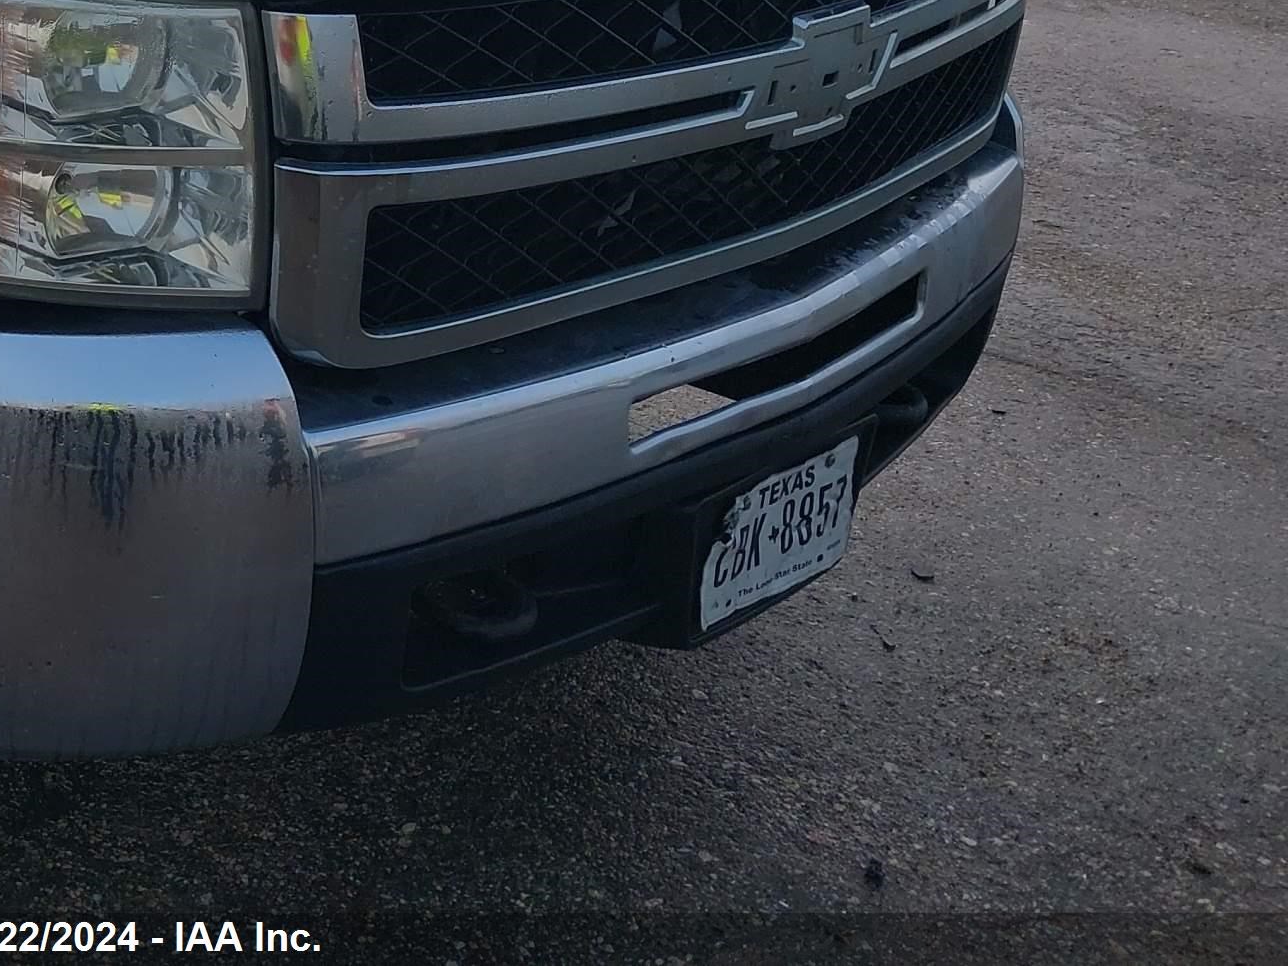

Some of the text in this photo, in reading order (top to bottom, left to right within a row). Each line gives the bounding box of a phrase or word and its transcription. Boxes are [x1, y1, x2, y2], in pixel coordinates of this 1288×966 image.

[759, 464, 816, 509] TEXAS
[780, 475, 848, 555] 8857
[738, 586, 754, 597] The
[774, 568, 792, 580] Star
[792, 559, 813, 572] State
